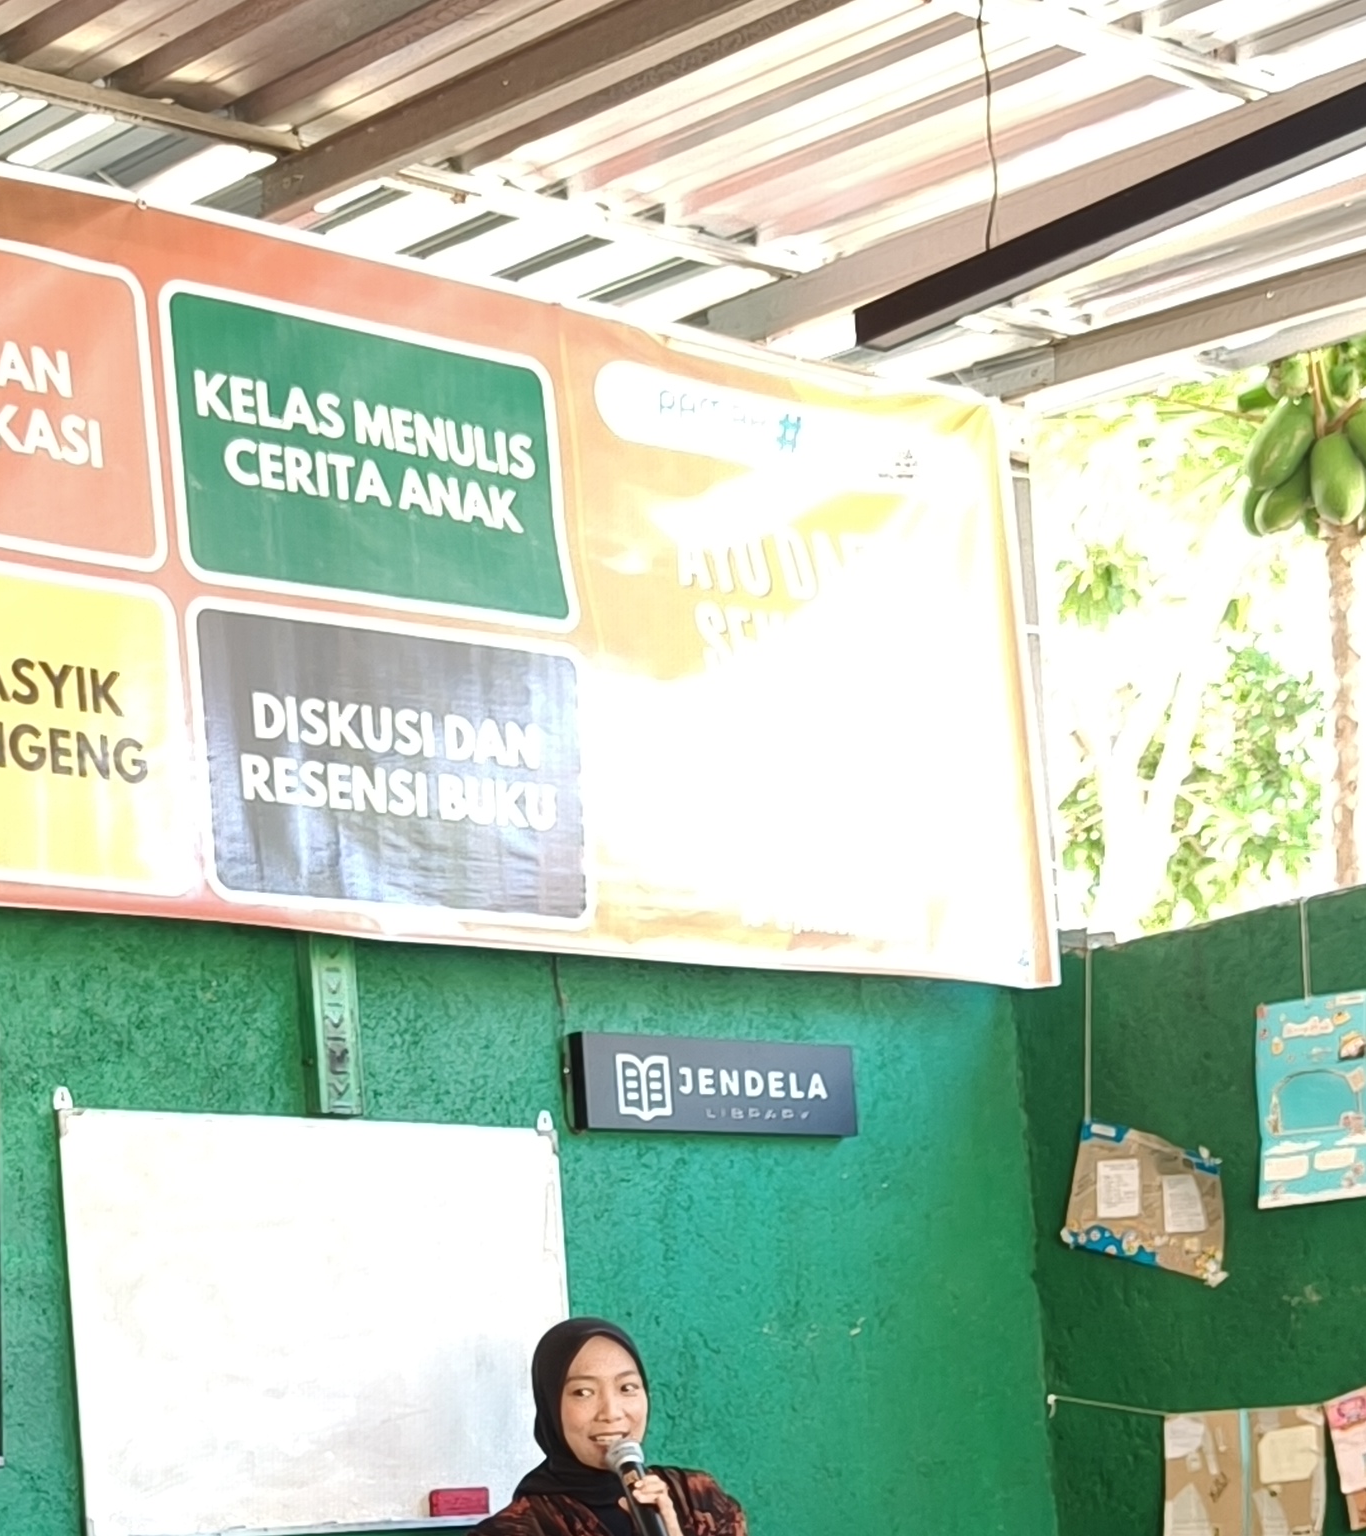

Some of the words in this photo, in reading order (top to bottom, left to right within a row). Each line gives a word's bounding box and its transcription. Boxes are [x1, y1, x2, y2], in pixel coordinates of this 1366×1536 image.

[192, 368, 346, 441] KELAS
[353, 399, 537, 482] MENULIS
[222, 438, 392, 510] CERITA
[397, 467, 526, 535] ANAK
[250, 692, 435, 759] DISKUSI
[442, 714, 542, 772] DAN
[239, 754, 431, 819] RESENSI
[438, 774, 559, 833] BUKU
[678, 1066, 828, 1100] JENDELA
